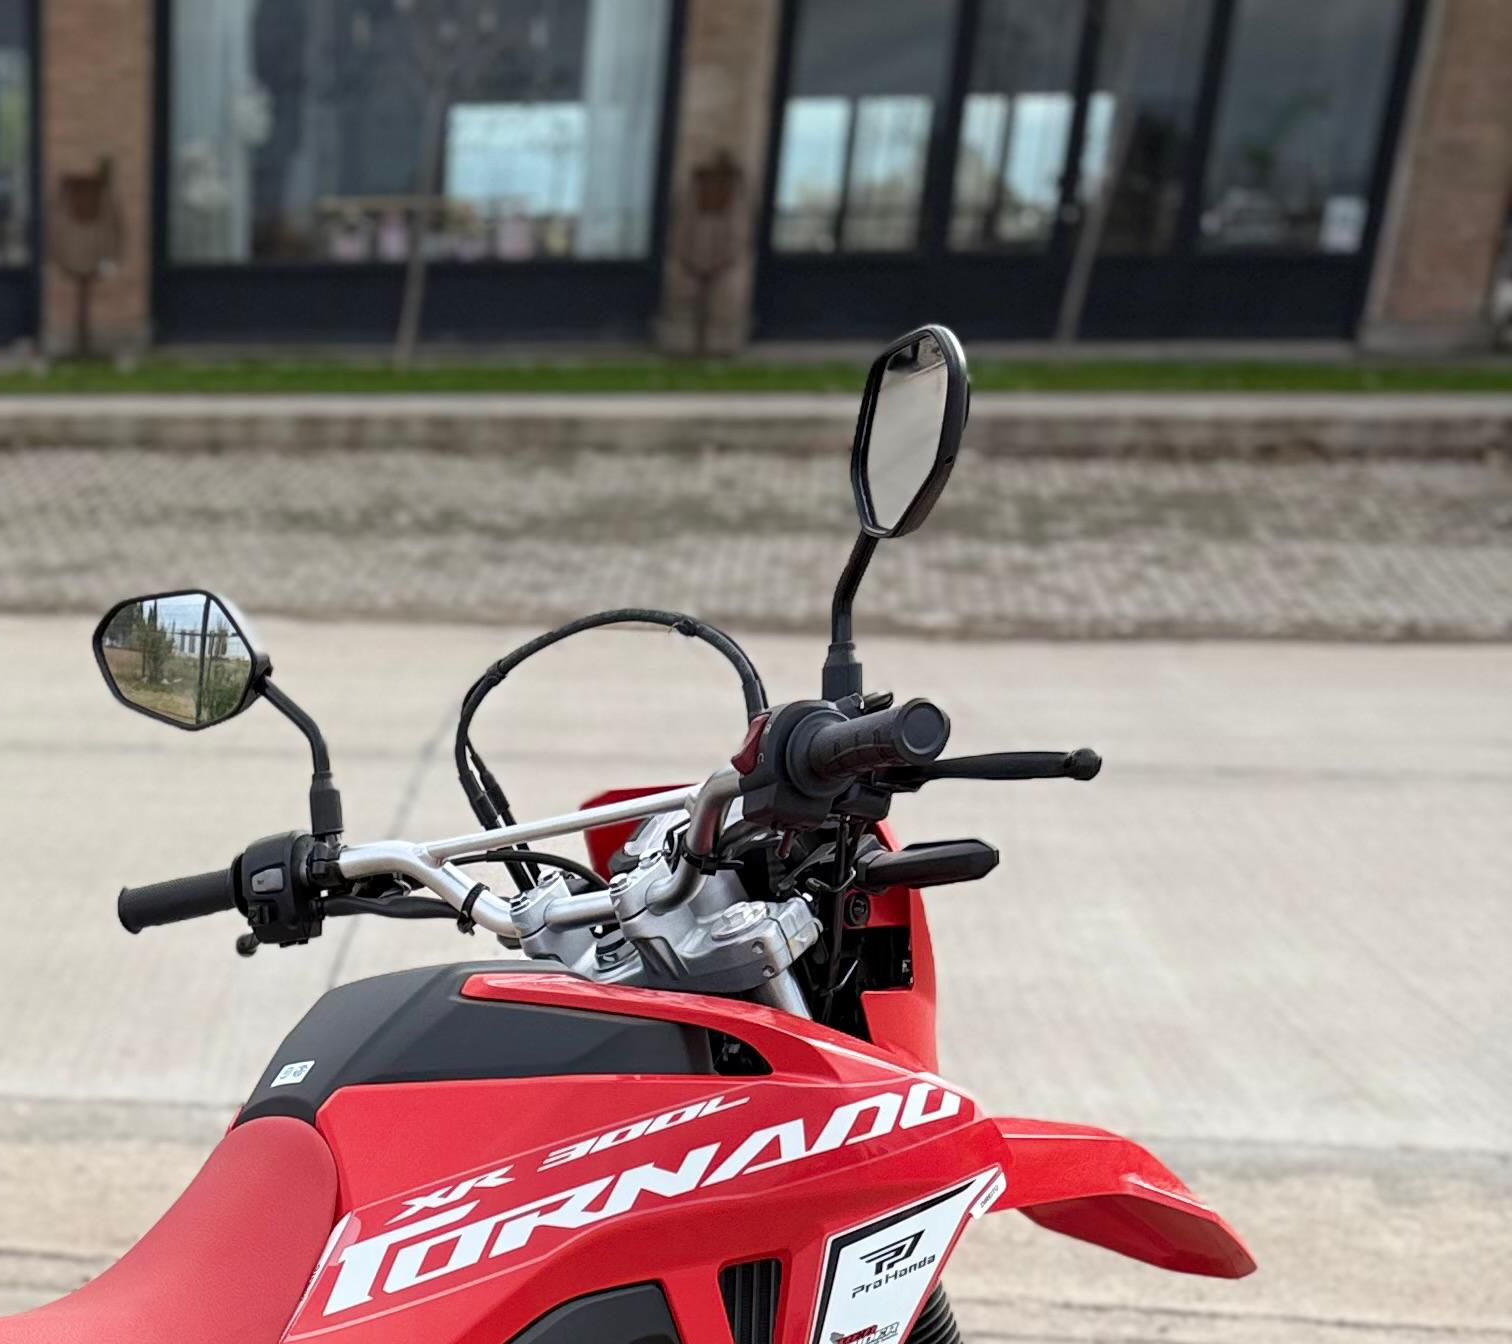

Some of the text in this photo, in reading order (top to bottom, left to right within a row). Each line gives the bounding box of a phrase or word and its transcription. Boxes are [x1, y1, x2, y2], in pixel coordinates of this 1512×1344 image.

[322, 1082, 961, 1316] TORNADO
[385, 1096, 750, 1225] XR 300L
[885, 1254, 936, 1284] Honda
